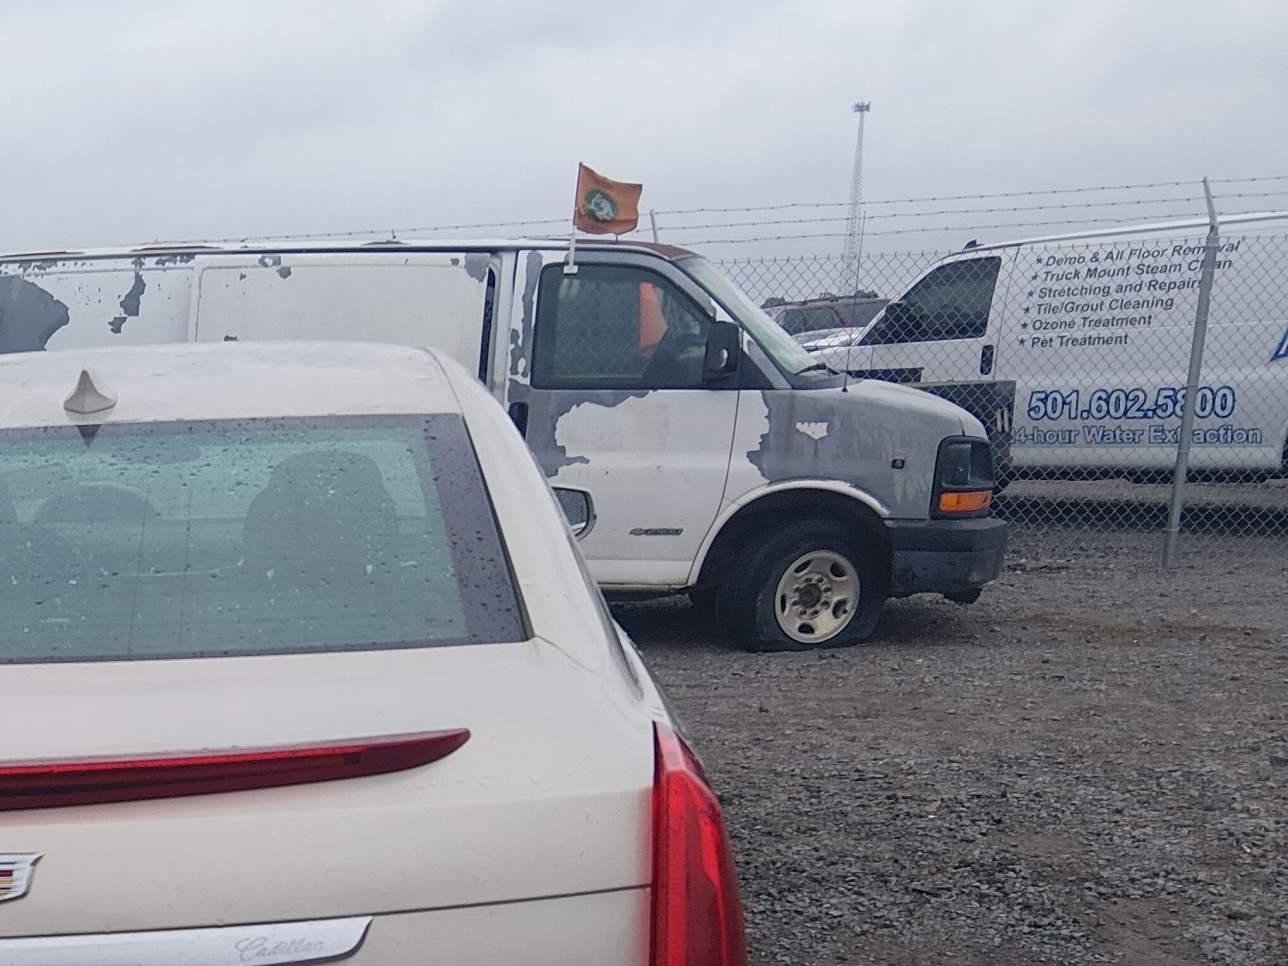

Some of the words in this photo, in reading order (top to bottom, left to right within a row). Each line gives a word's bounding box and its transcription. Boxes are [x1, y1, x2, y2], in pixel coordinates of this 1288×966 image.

[1045, 254, 1086, 267] Demo
[1089, 251, 1100, 263] &
[1103, 249, 1125, 261] All
[1127, 247, 1169, 260] Floor
[1171, 239, 1241, 257] Remval
[1043, 269, 1081, 282] Truck
[1085, 266, 1131, 281] Mount
[1134, 262, 1183, 276] Steam
[1187, 258, 1233, 272] Clan
[1038, 284, 1111, 299] Stretching
[1115, 281, 1143, 294] and
[1036, 300, 1105, 315] Tile/Grout
[1108, 296, 1174, 311] Cleaning
[1032, 319, 1076, 331] Ozone
[1080, 314, 1152, 328] Treatment
[1031, 336, 1054, 348] Pet
[1058, 332, 1128, 347] Treatment
[1082, 424, 1144, 444] Water
[234, 936, 324, 961] Cadillac
